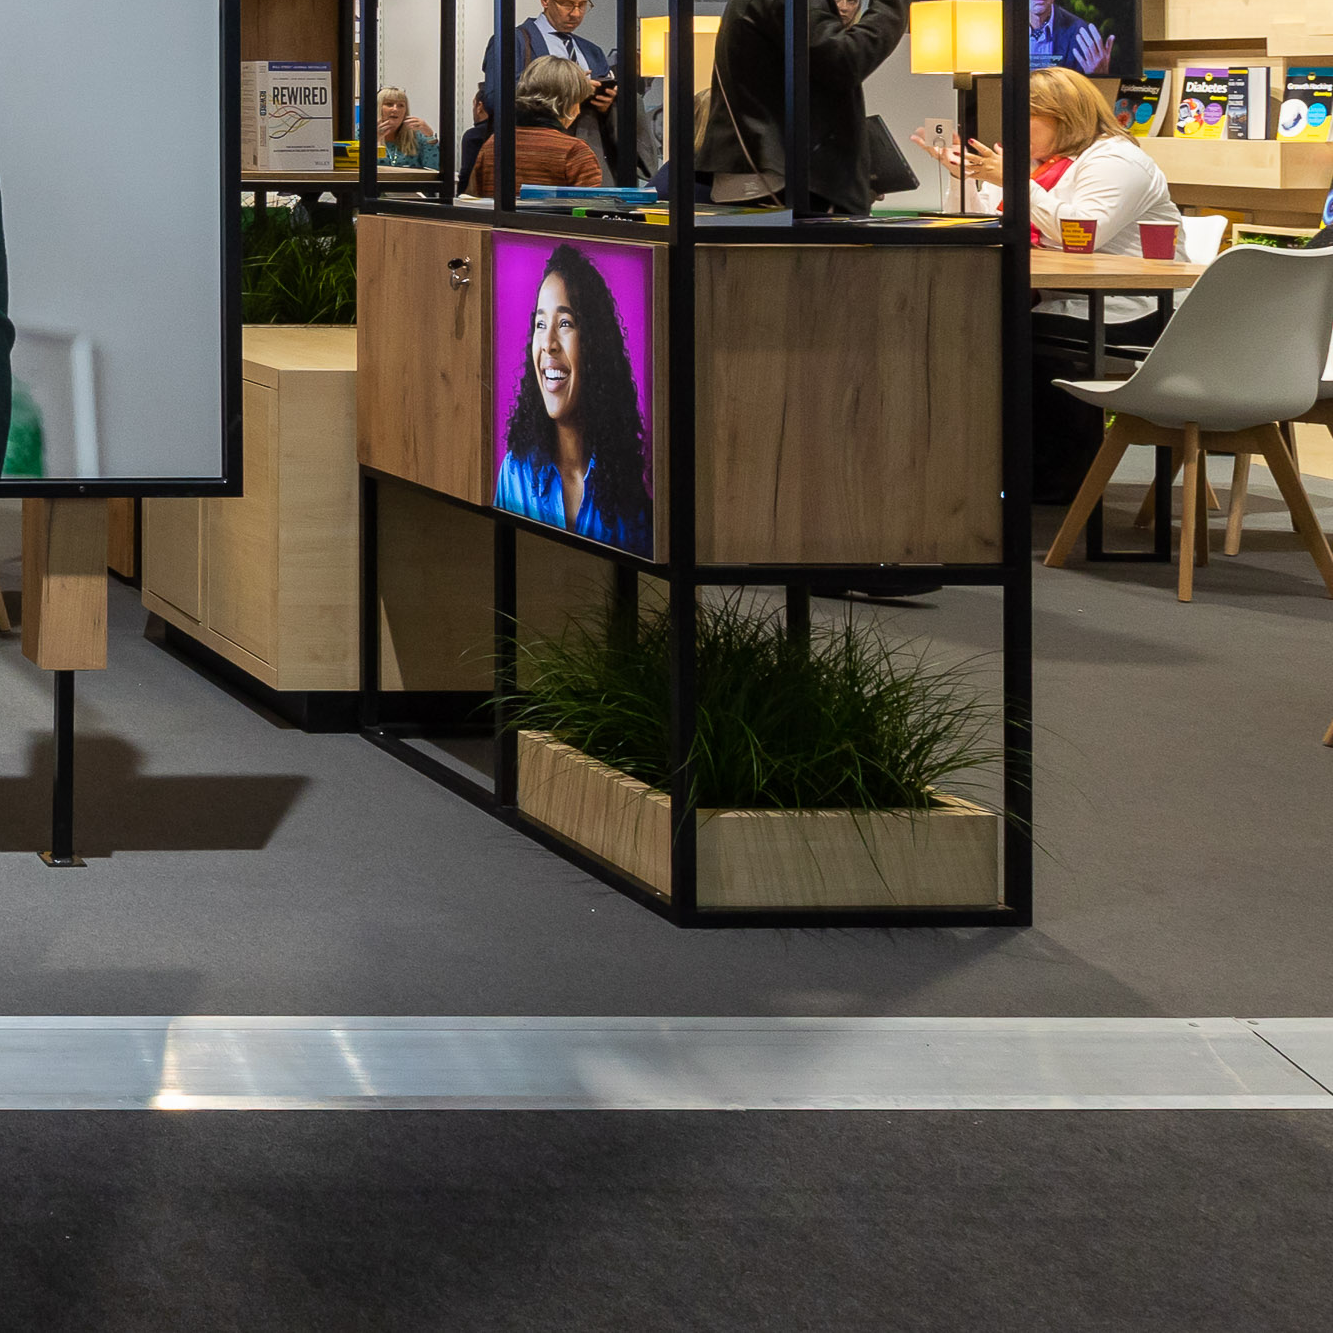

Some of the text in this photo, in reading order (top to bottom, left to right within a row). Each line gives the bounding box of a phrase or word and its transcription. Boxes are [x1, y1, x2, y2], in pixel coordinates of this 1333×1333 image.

[1185, 81, 1228, 93] Diabetes
[272, 86, 328, 106] REWIRED
[935, 124, 943, 134] 6
